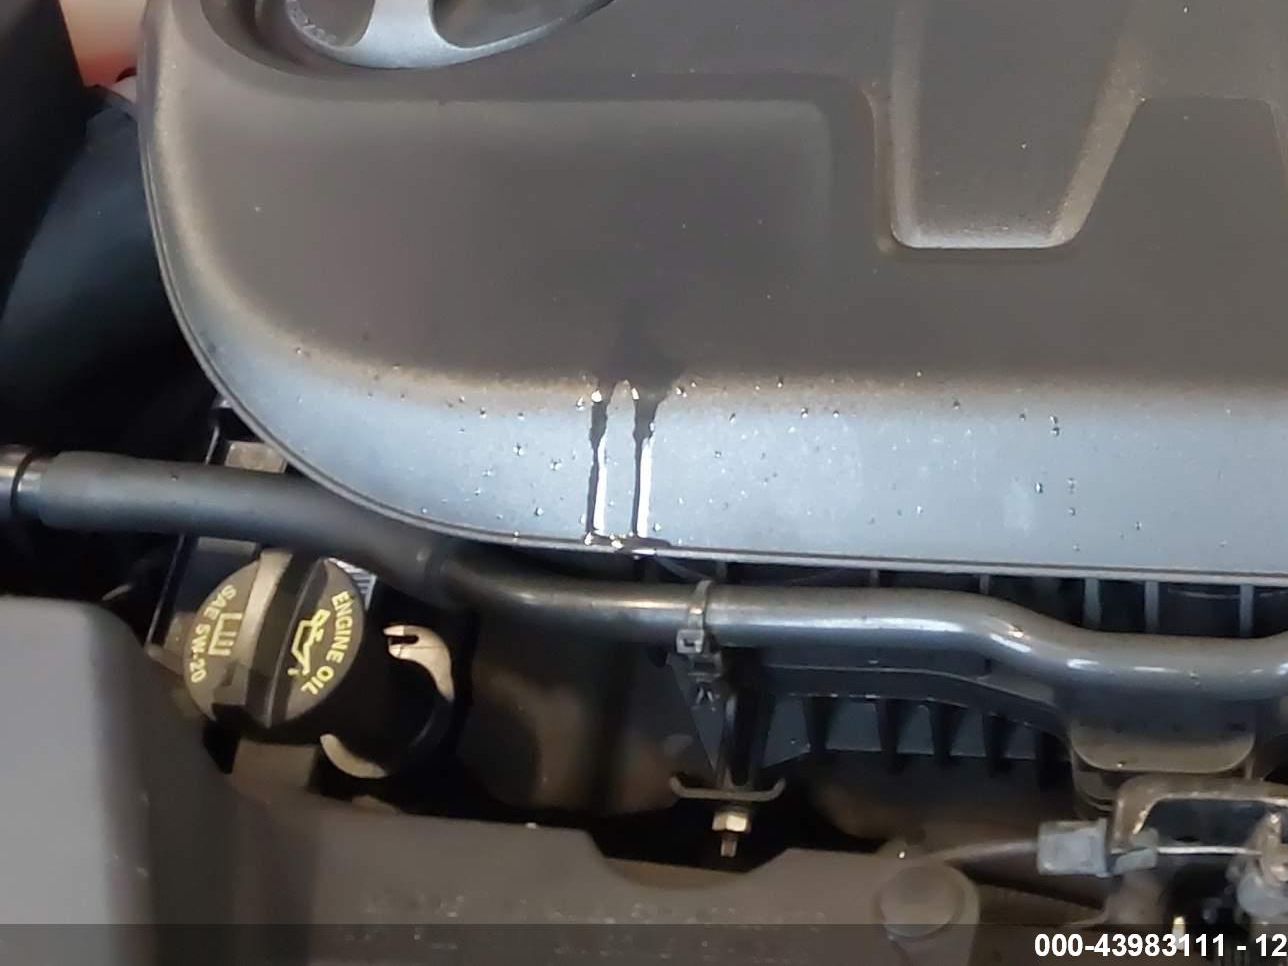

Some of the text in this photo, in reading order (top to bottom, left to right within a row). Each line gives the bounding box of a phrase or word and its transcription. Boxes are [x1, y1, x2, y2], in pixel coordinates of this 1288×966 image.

[189, 584, 237, 683] SAE 5W-20
[300, 590, 353, 695] ENGINE OIL
